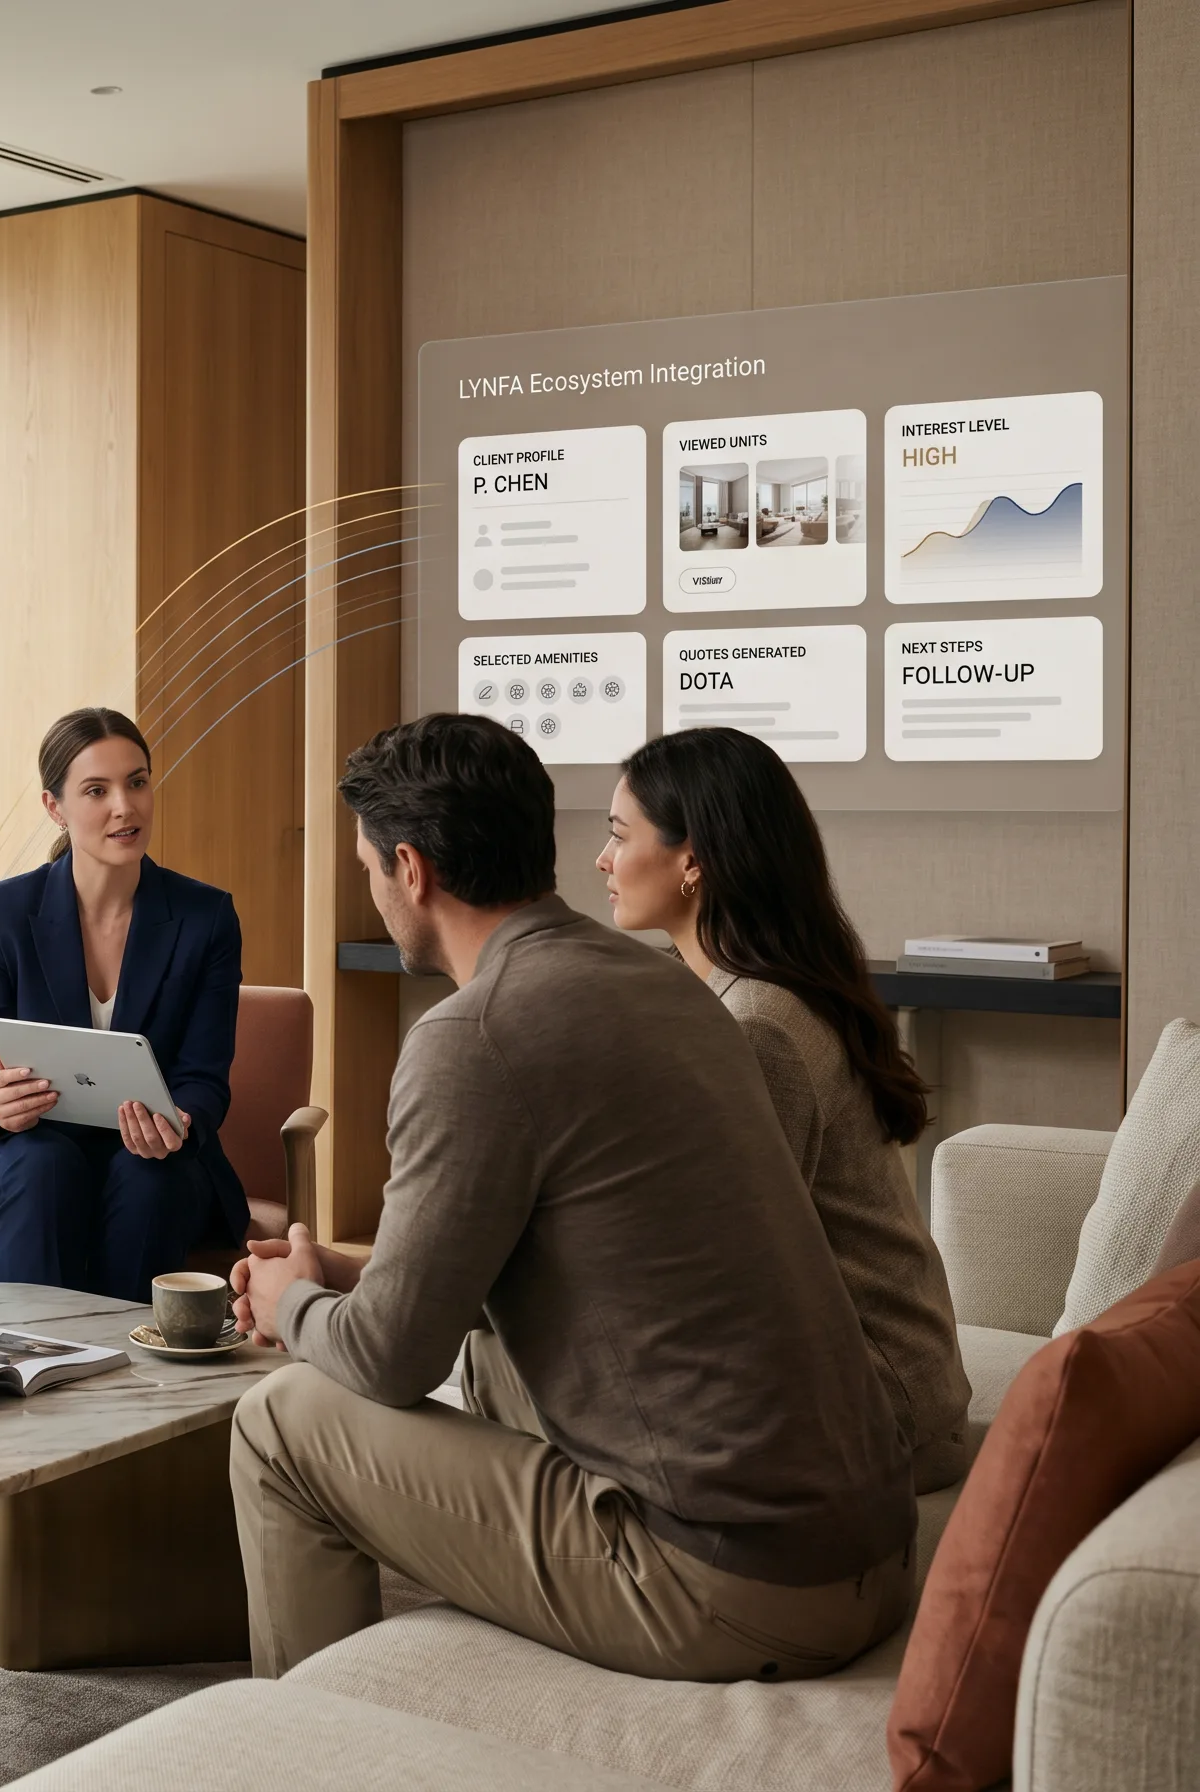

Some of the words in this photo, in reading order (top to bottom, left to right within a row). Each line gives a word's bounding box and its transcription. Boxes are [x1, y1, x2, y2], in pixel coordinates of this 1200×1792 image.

[458, 373, 524, 399] LYNFA
[530, 367, 643, 395] Ecosystem
[650, 355, 766, 386] Integration
[901, 420, 966, 437] INTEREST
[968, 418, 1010, 433] LEVEL
[678, 436, 727, 452] VIEWED
[729, 433, 768, 448] UNITS
[473, 452, 514, 467] CLIENT
[516, 448, 565, 464] PROFILE
[902, 445, 958, 468] HIGH
[473, 475, 488, 495] P.
[493, 472, 549, 493] CHEN
[679, 648, 729, 663] QUOTES
[731, 645, 807, 660] GENERATED
[901, 641, 937, 655] NEXT
[939, 640, 984, 654] STEPS
[473, 653, 532, 667] SELECTED
[534, 650, 599, 665] AMENITIES
[680, 671, 735, 691] DOTA
[902, 662, 1036, 685] FOLLOW-UP
